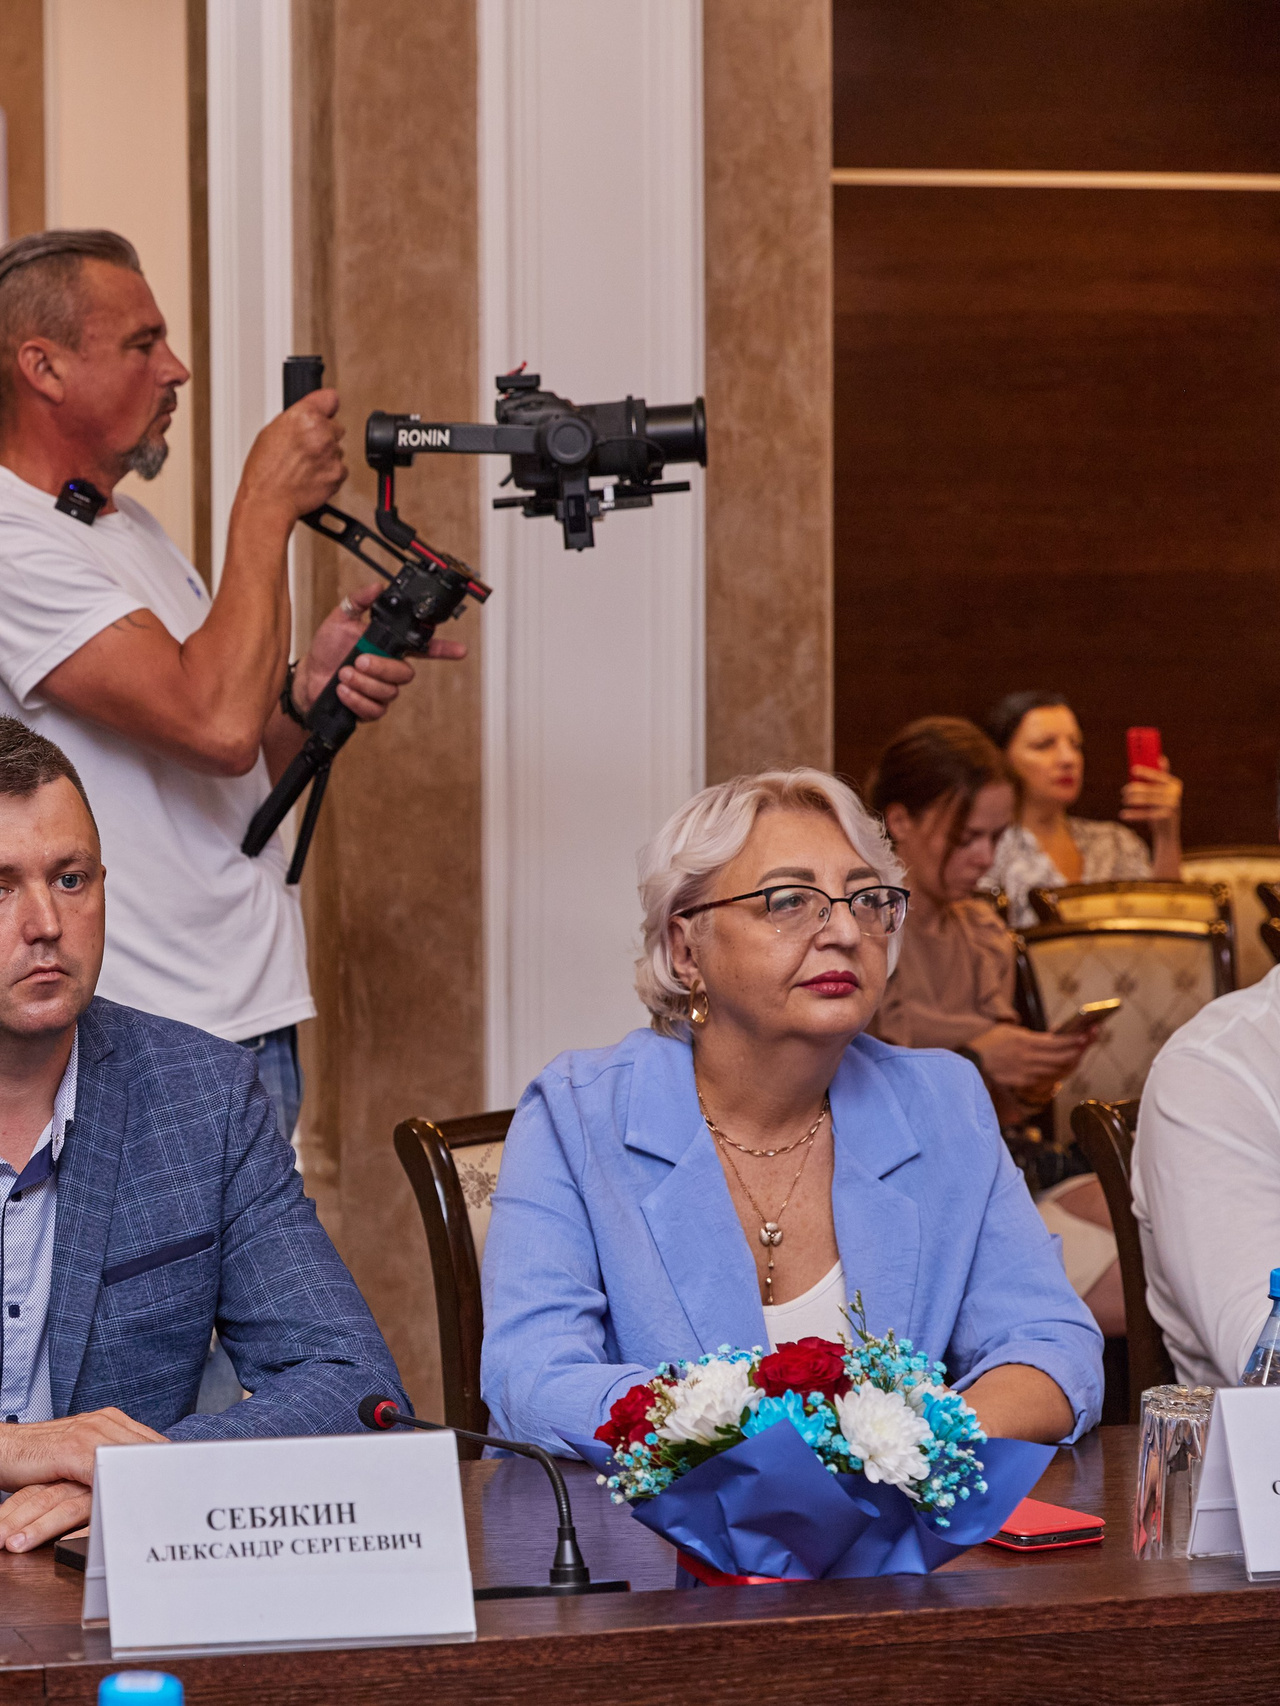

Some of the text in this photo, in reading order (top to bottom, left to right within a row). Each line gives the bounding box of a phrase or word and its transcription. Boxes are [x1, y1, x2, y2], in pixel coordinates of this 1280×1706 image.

[397, 428, 450, 447] RONIN
[206, 1502, 357, 1531] СЕБЯКИН
[146, 1533, 422, 1562] АЛЕКСАНДР СЕРГЕЕВИЧ
